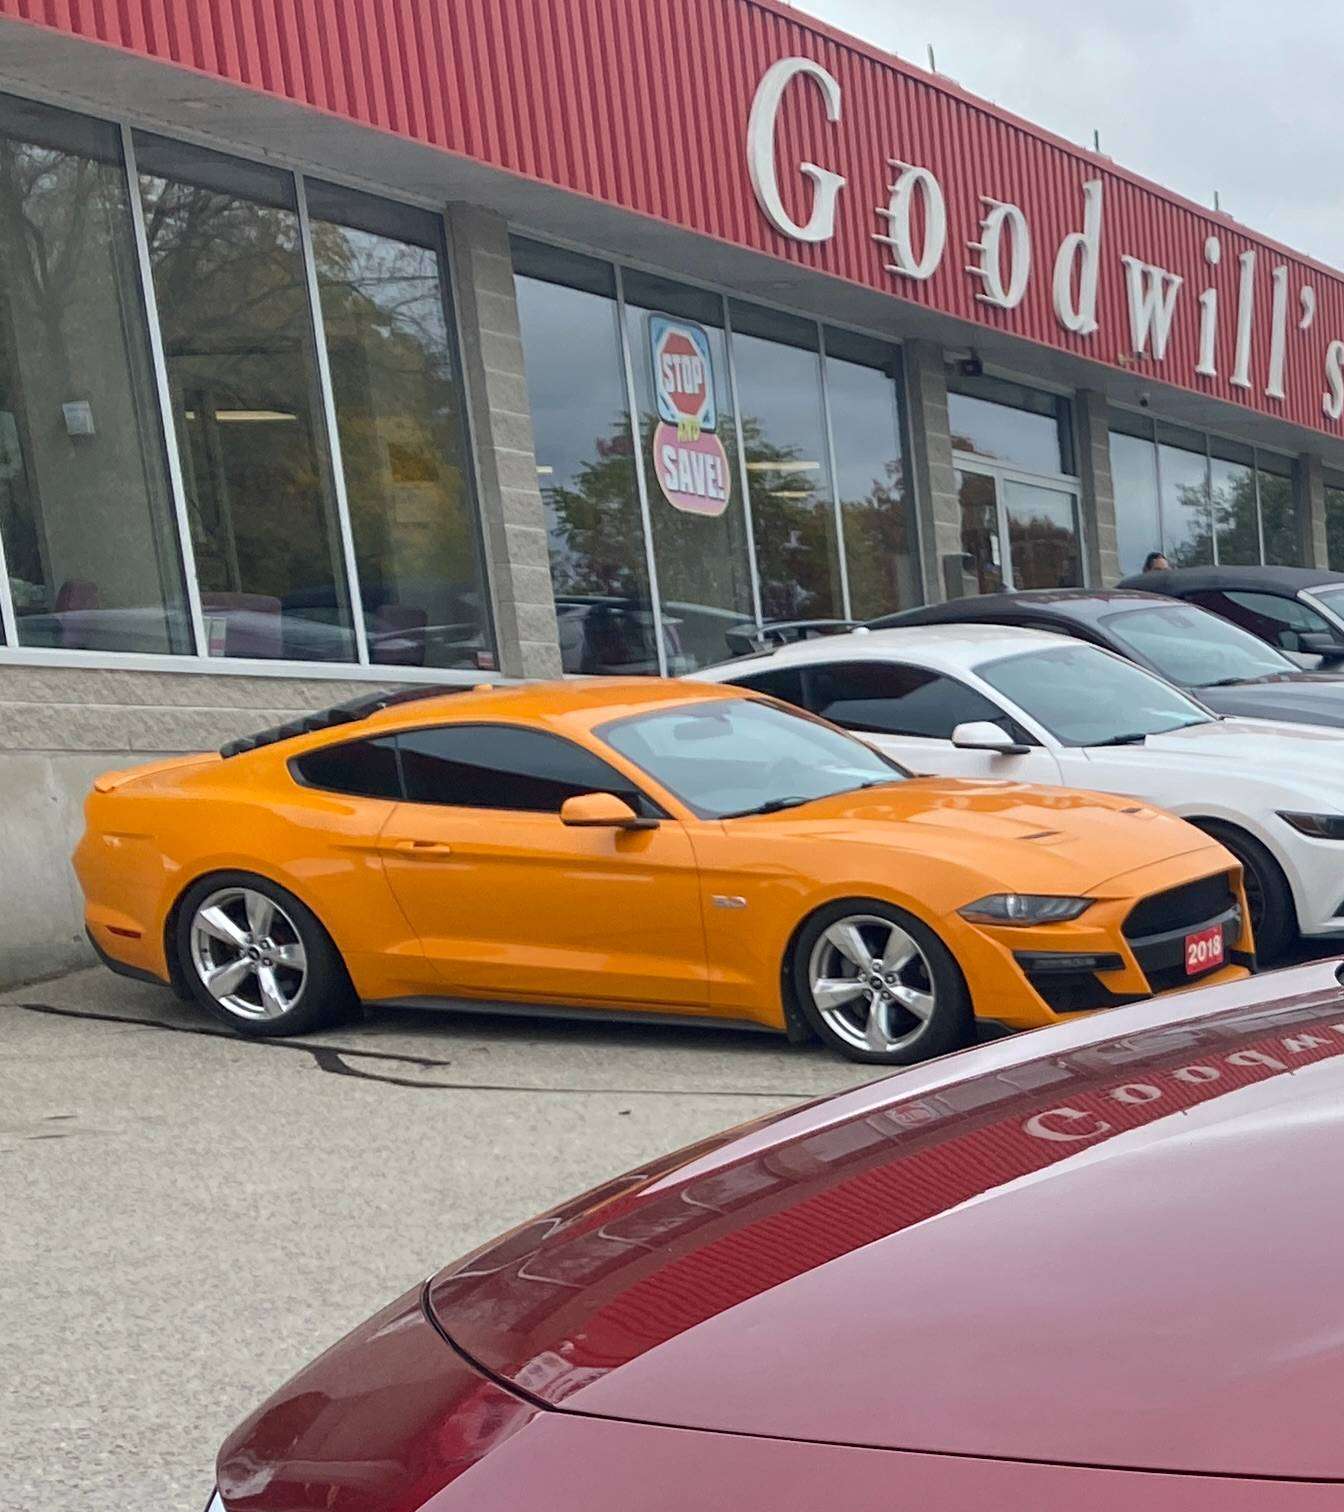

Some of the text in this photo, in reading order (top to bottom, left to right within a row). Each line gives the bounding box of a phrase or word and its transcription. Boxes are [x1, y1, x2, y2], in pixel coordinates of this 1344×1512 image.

[662, 353, 703, 395] STOP
[661, 444, 726, 501] SAVE!
[1188, 934, 1221, 964] 2018
